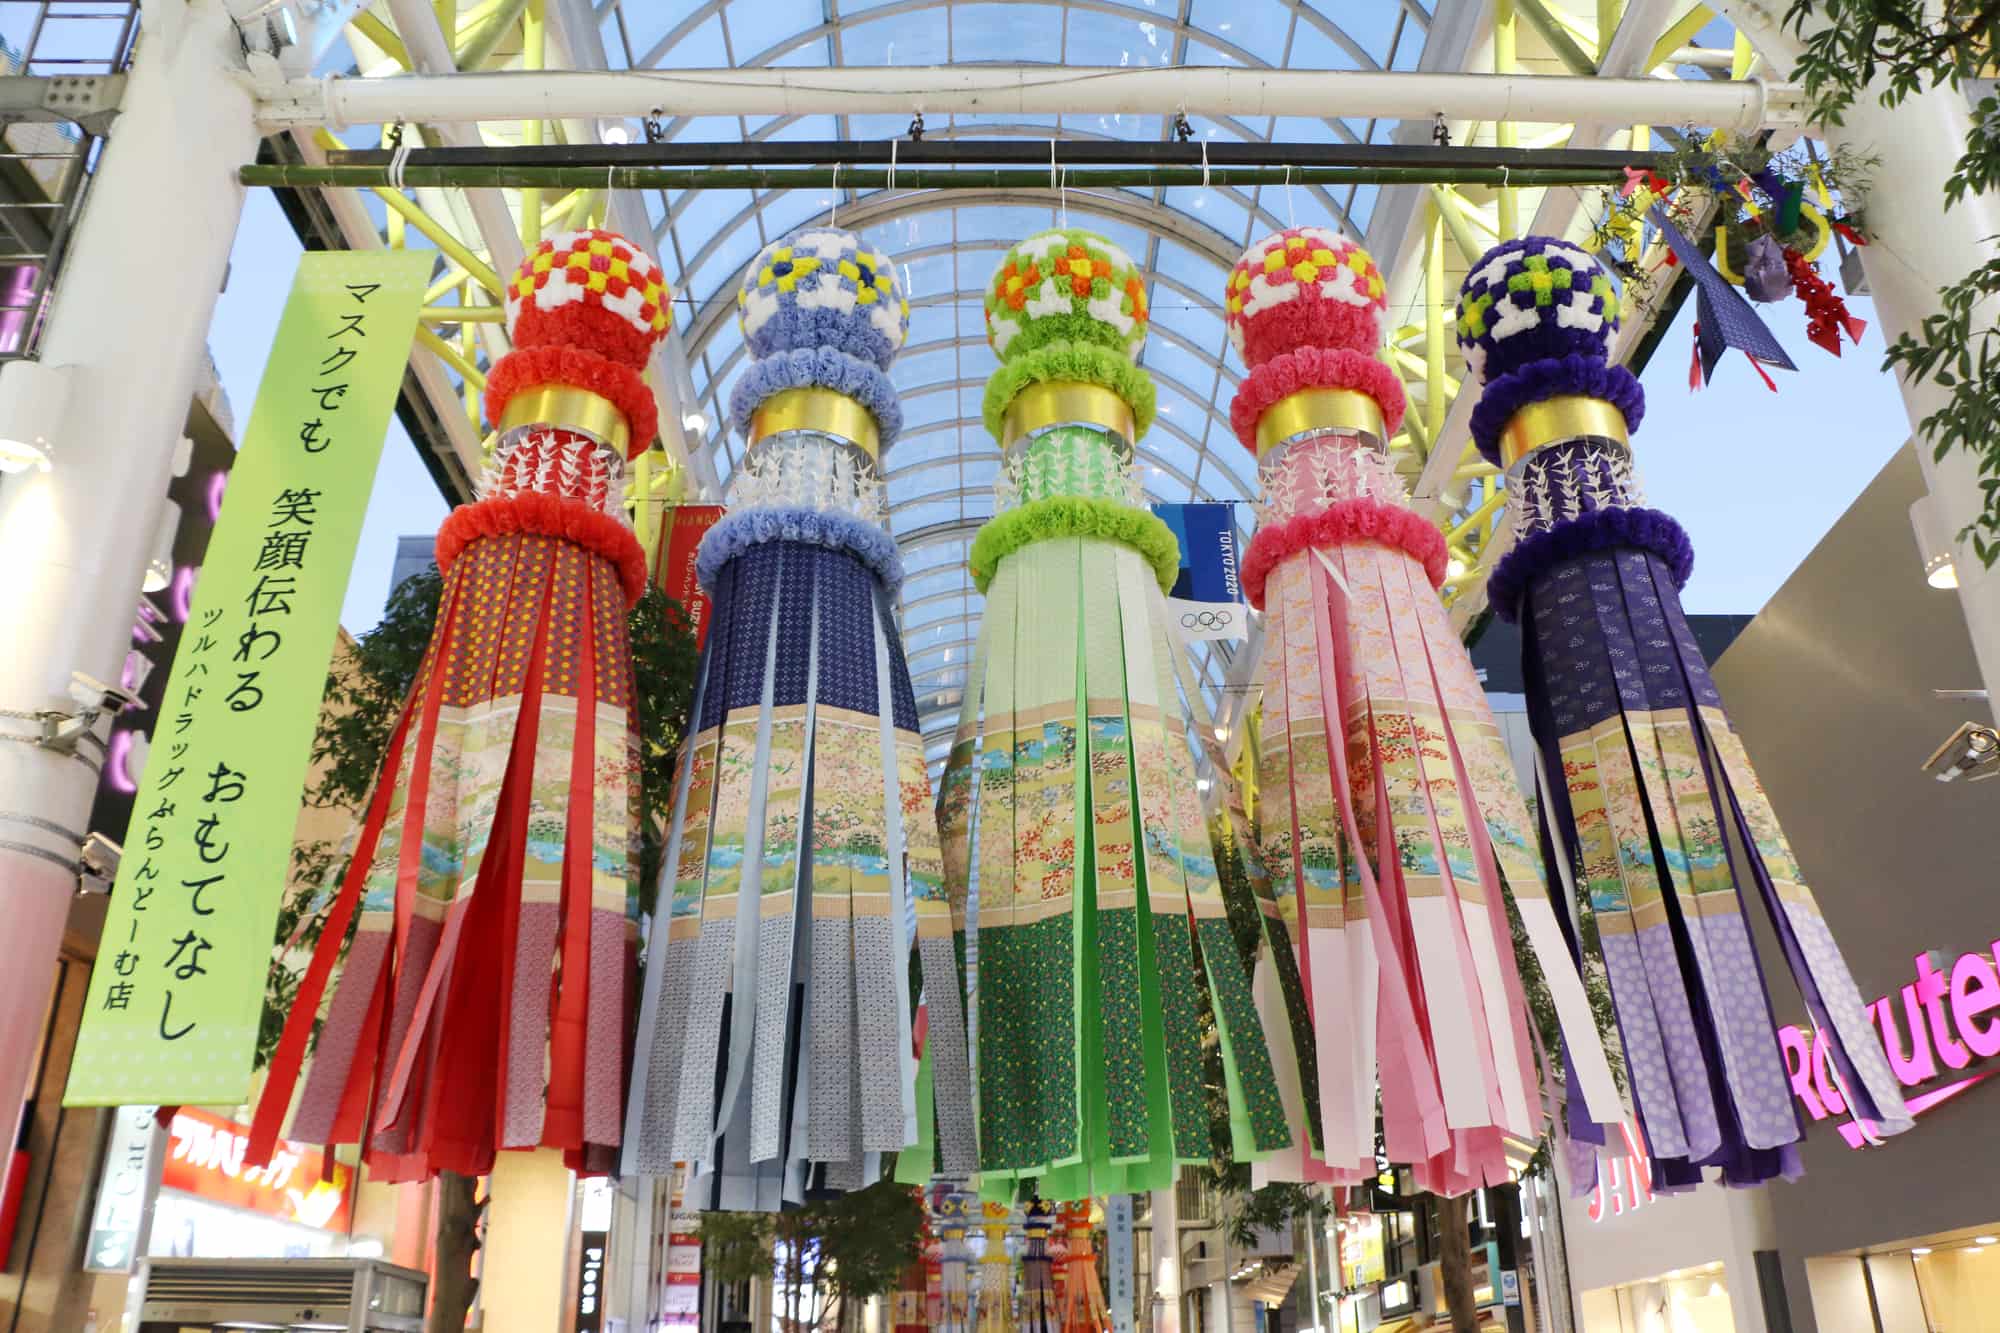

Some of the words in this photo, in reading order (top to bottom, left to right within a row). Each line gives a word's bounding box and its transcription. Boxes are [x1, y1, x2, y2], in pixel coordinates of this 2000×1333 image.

[300, 283, 381, 453] マスクでも
[224, 488, 322, 713] 笑顔伝わる
[1217, 530, 1235, 565] TOKYO
[1223, 567, 1239, 595] 2020
[158, 761, 247, 1041] おもてなし
[1778, 938, 2000, 1120] Raute
